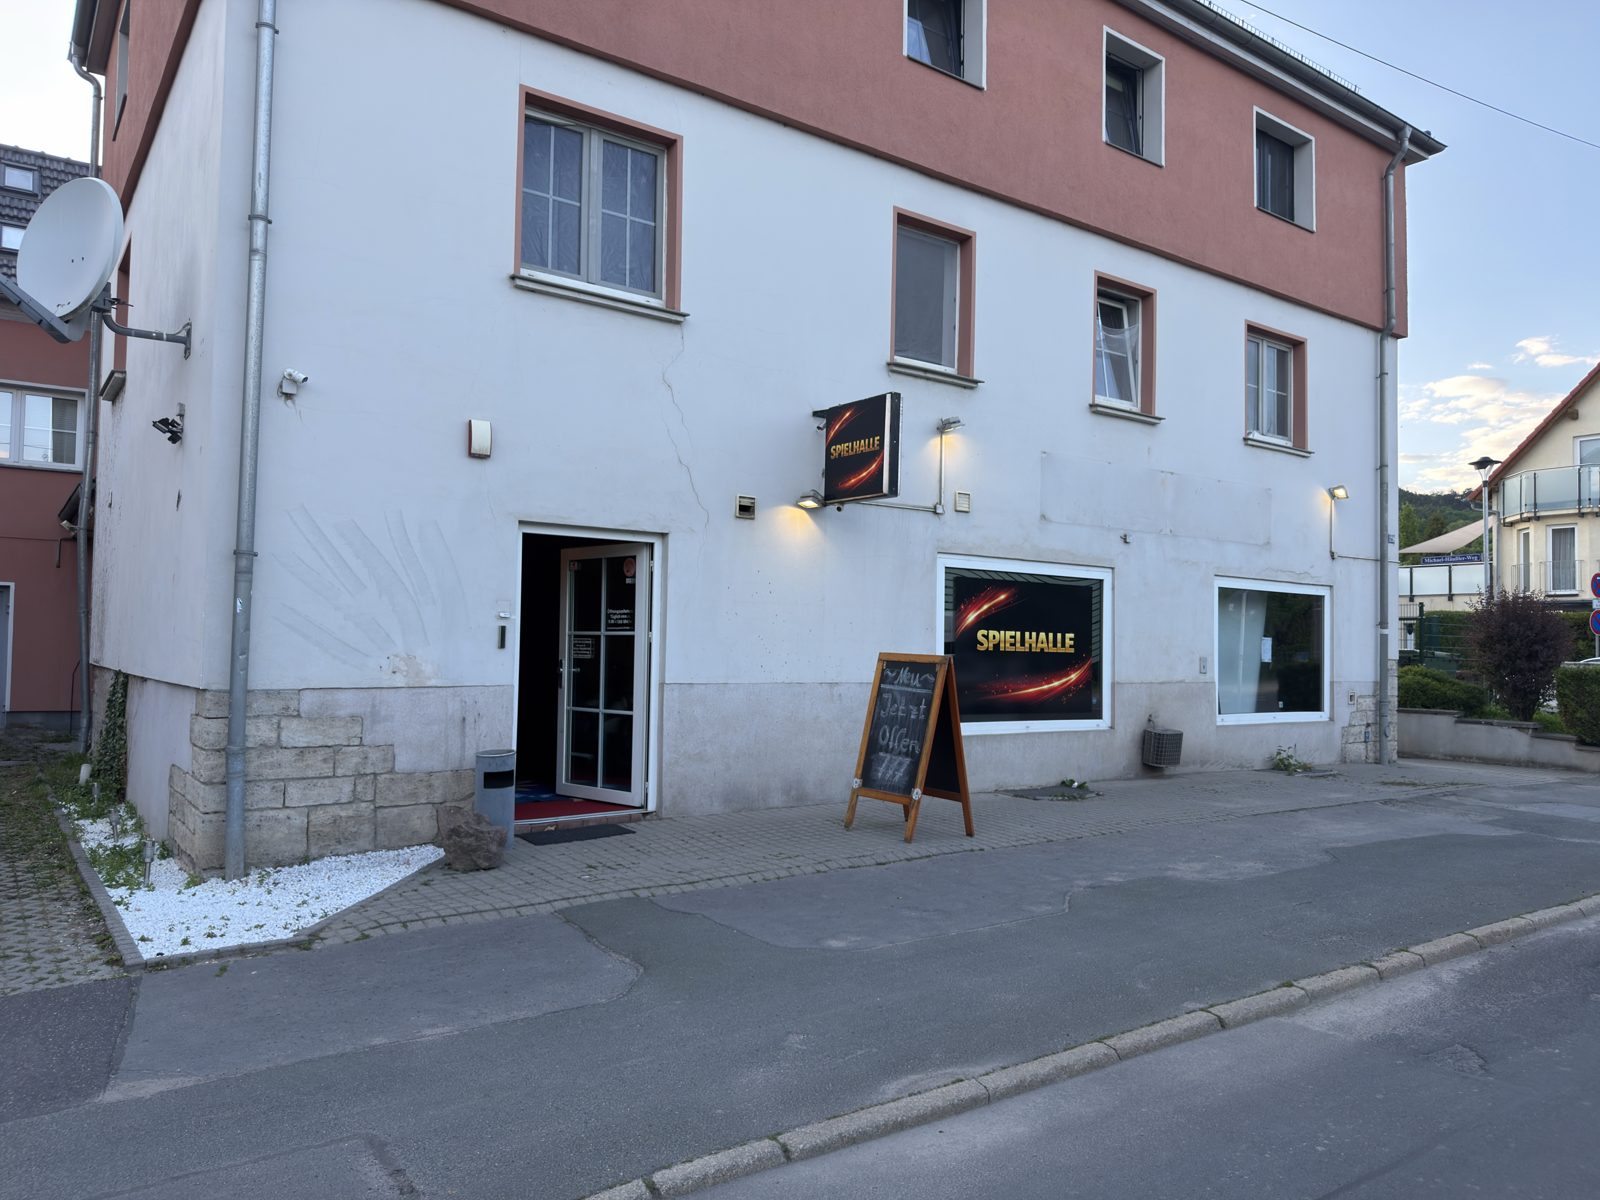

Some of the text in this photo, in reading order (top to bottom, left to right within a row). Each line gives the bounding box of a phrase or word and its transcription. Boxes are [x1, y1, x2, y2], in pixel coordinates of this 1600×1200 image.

[830, 435, 881, 460] SPIELHALLE
[976, 629, 1075, 653] SPIELHALLE
[880, 693, 927, 719] Jetzt
